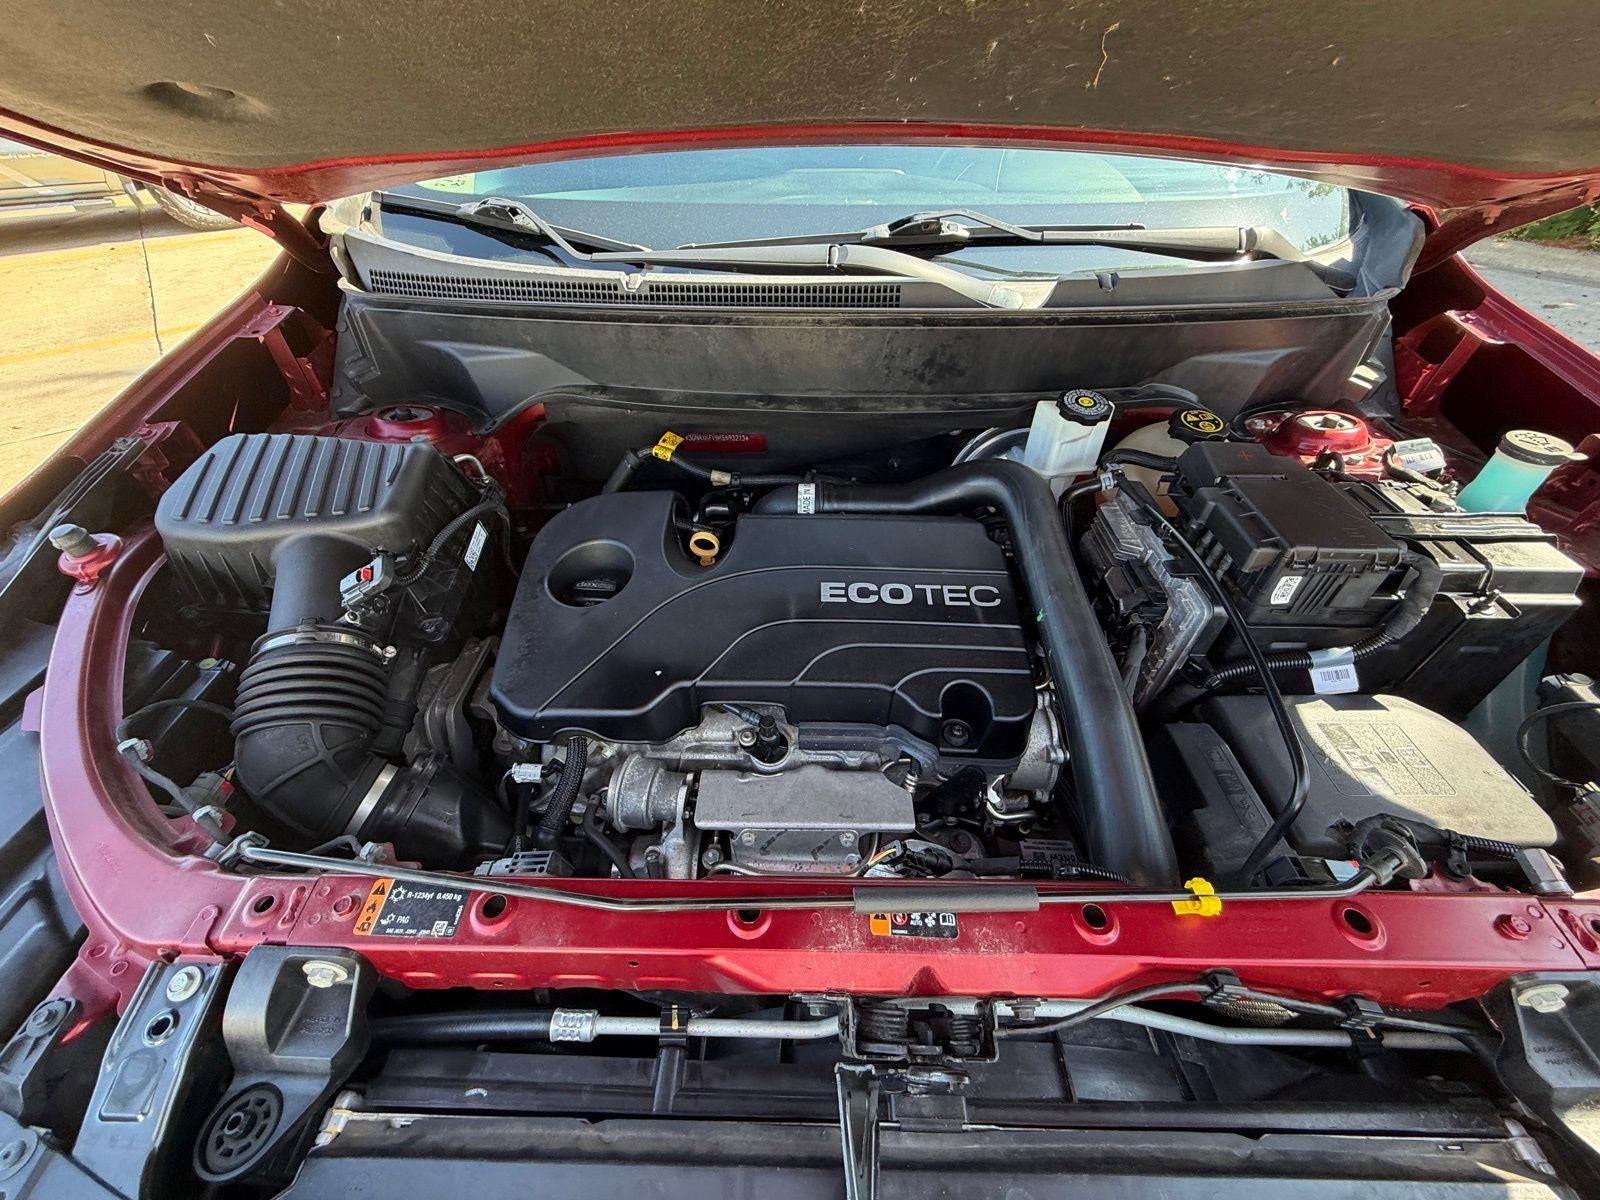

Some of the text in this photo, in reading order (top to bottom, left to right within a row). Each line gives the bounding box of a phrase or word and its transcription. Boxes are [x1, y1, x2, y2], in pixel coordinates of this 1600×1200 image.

[820, 582, 1001, 607] ECOTEC
[406, 891, 462, 902] R-1234yf 0.450 kg
[396, 915, 411, 924] PAG
[910, 918, 923, 926] AUTO
